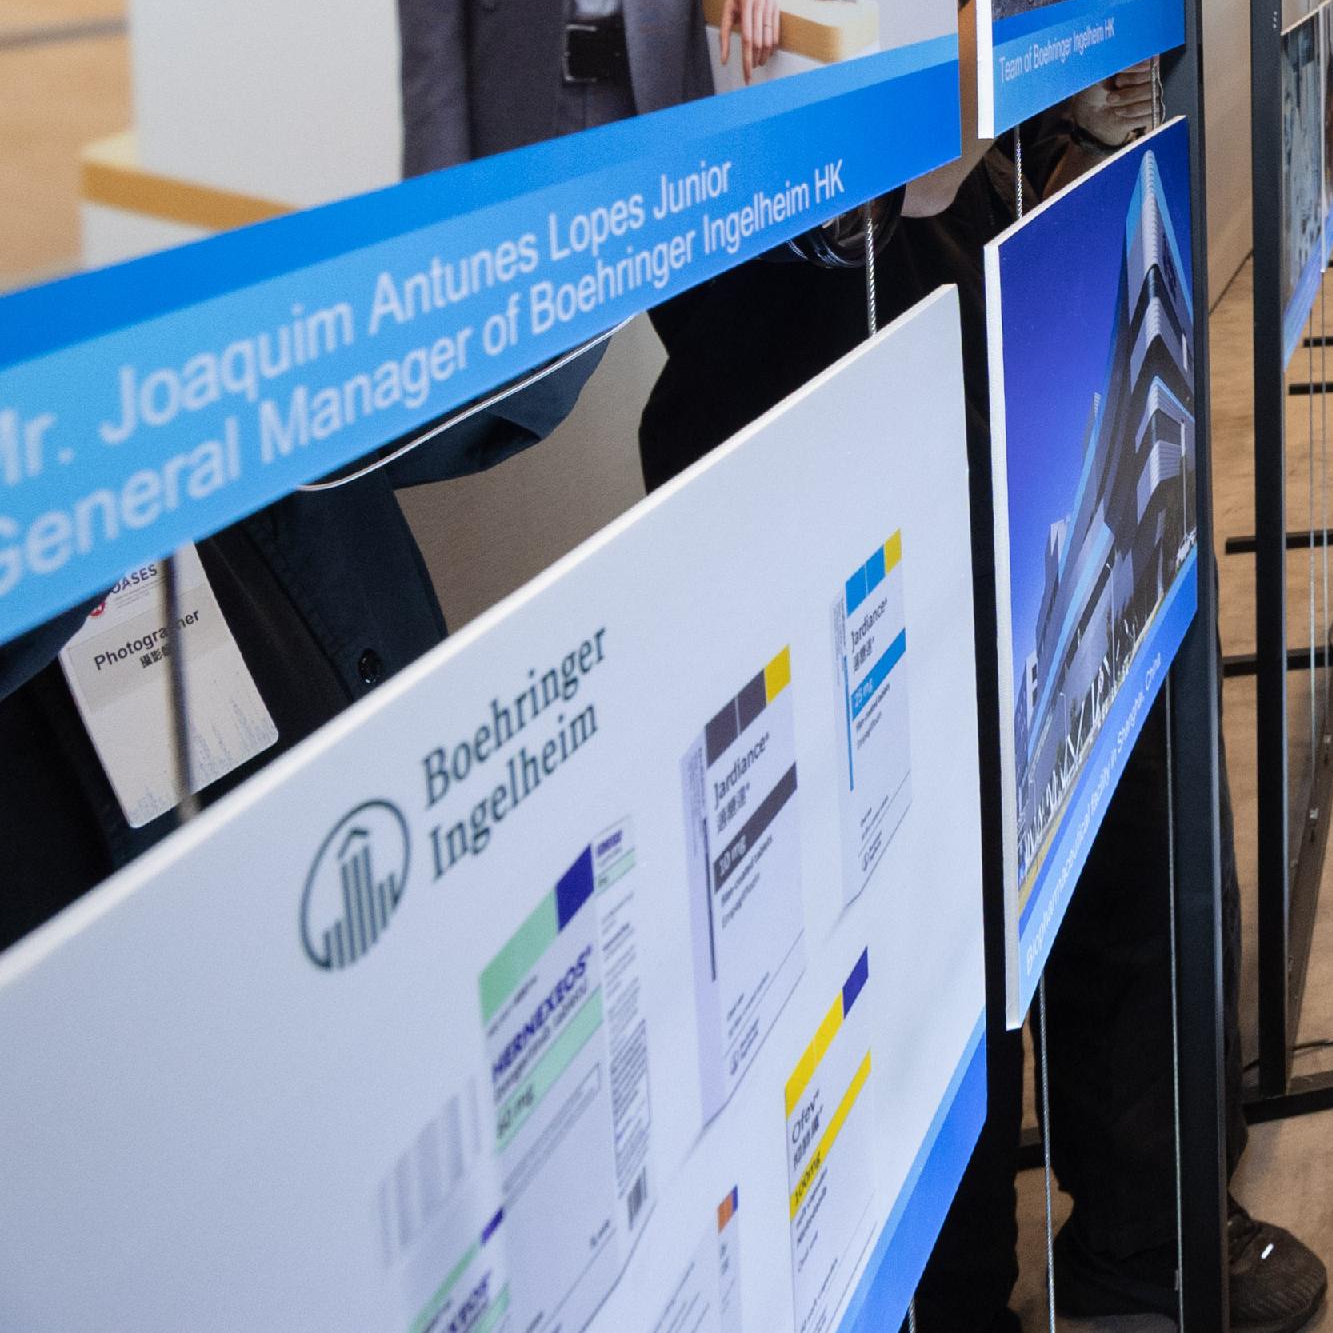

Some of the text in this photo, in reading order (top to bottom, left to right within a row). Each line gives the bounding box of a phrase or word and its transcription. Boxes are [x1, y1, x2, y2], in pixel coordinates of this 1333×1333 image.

[999, 17, 1115, 83] Team of Boehringer Ingelheim HK
[0, 160, 732, 486] r. Joaquim Antunes Lopes Junior
[258, 326, 475, 465] Manager
[481, 292, 522, 356] of
[530, 228, 697, 336] Boehringer
[703, 180, 810, 256] Ingelheim
[814, 158, 846, 203] HK
[93, 610, 200, 671] Photograer
[421, 626, 607, 810] Boehringer
[428, 701, 599, 883] Ingelheim
